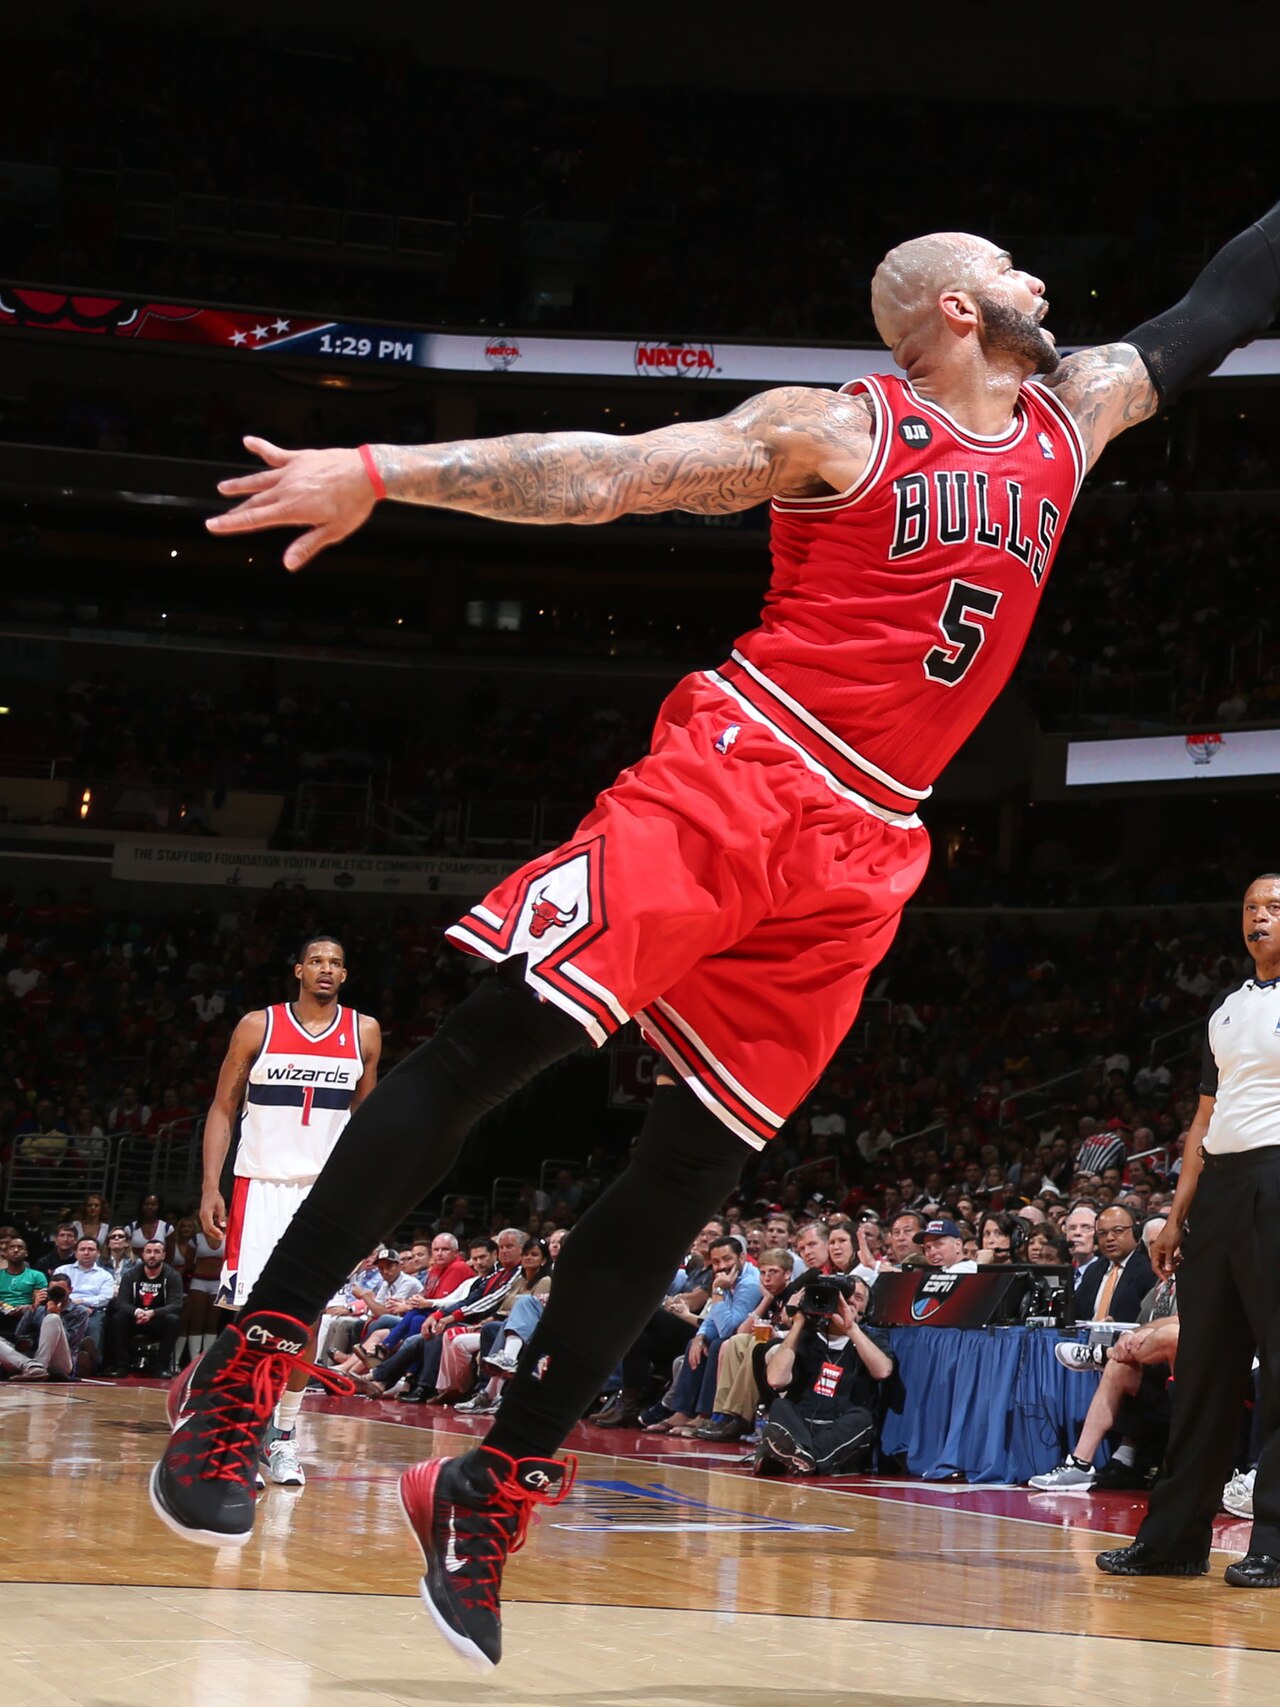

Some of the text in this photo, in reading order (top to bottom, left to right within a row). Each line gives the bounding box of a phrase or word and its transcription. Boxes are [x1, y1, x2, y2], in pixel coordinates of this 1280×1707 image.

[319, 334, 413, 361] 1:29 PM
[637, 347, 715, 369] NATCA
[902, 425, 929, 441] DJR
[889, 471, 1060, 589] BULLS
[923, 578, 1003, 688] 5
[134, 847, 152, 860] THE
[156, 849, 212, 864] STAFFORD
[215, 853, 281, 867] FOUNDATION
[283, 856, 317, 868] YOUTH
[319, 858, 373, 871] ATHLETICS
[376, 860, 436, 873] COMMUNITY
[438, 862, 497, 875] CHAMPIONS
[267, 1064, 350, 1083] wizards
[301, 1085, 315, 1126] 1
